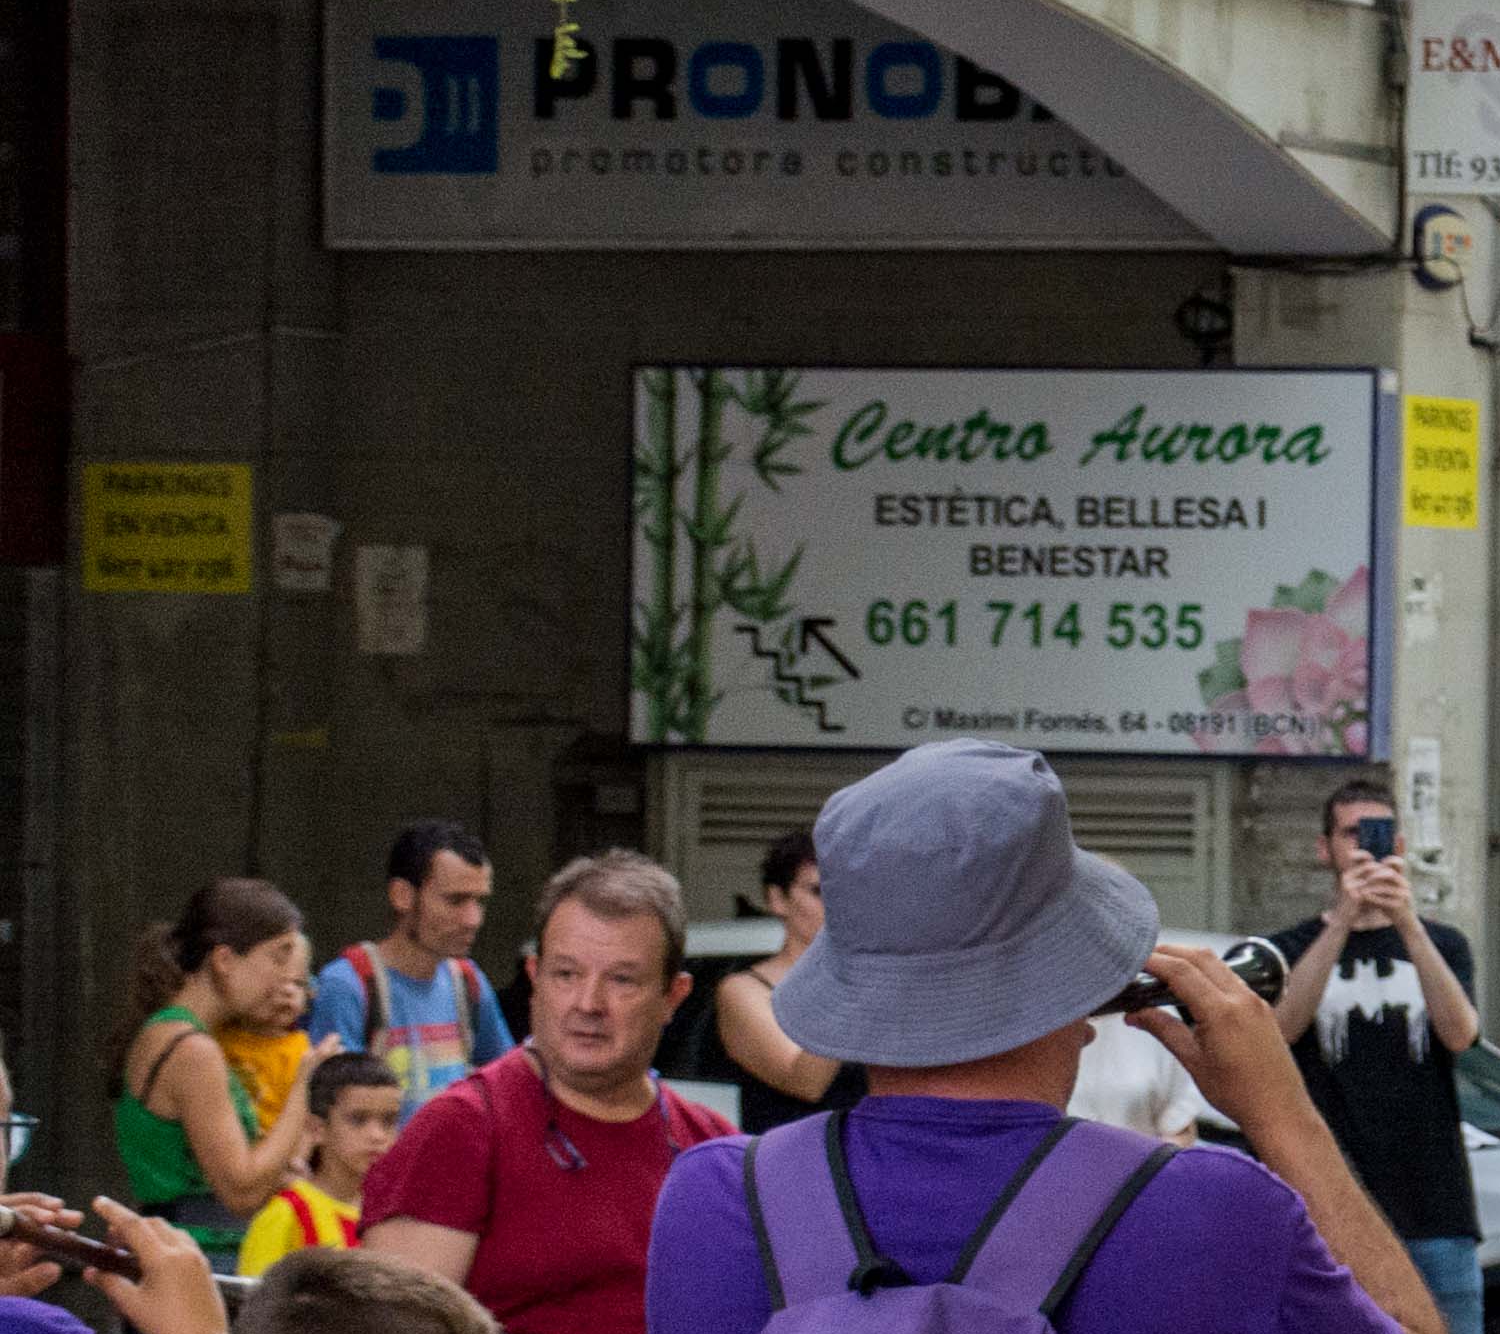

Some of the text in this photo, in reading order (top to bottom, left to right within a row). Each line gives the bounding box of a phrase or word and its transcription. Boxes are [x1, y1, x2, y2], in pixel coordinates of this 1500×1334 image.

[533, 36, 1058, 123] PRONOB
[529, 144, 804, 181] promotora
[829, 398, 1334, 470] Centro Aurora
[873, 485, 1266, 531] ESTÈTICA, BELLESA I
[969, 545, 1172, 580] BENESTAR
[864, 598, 1205, 651] 661 714 535
[1118, 711, 1147, 733] 64
